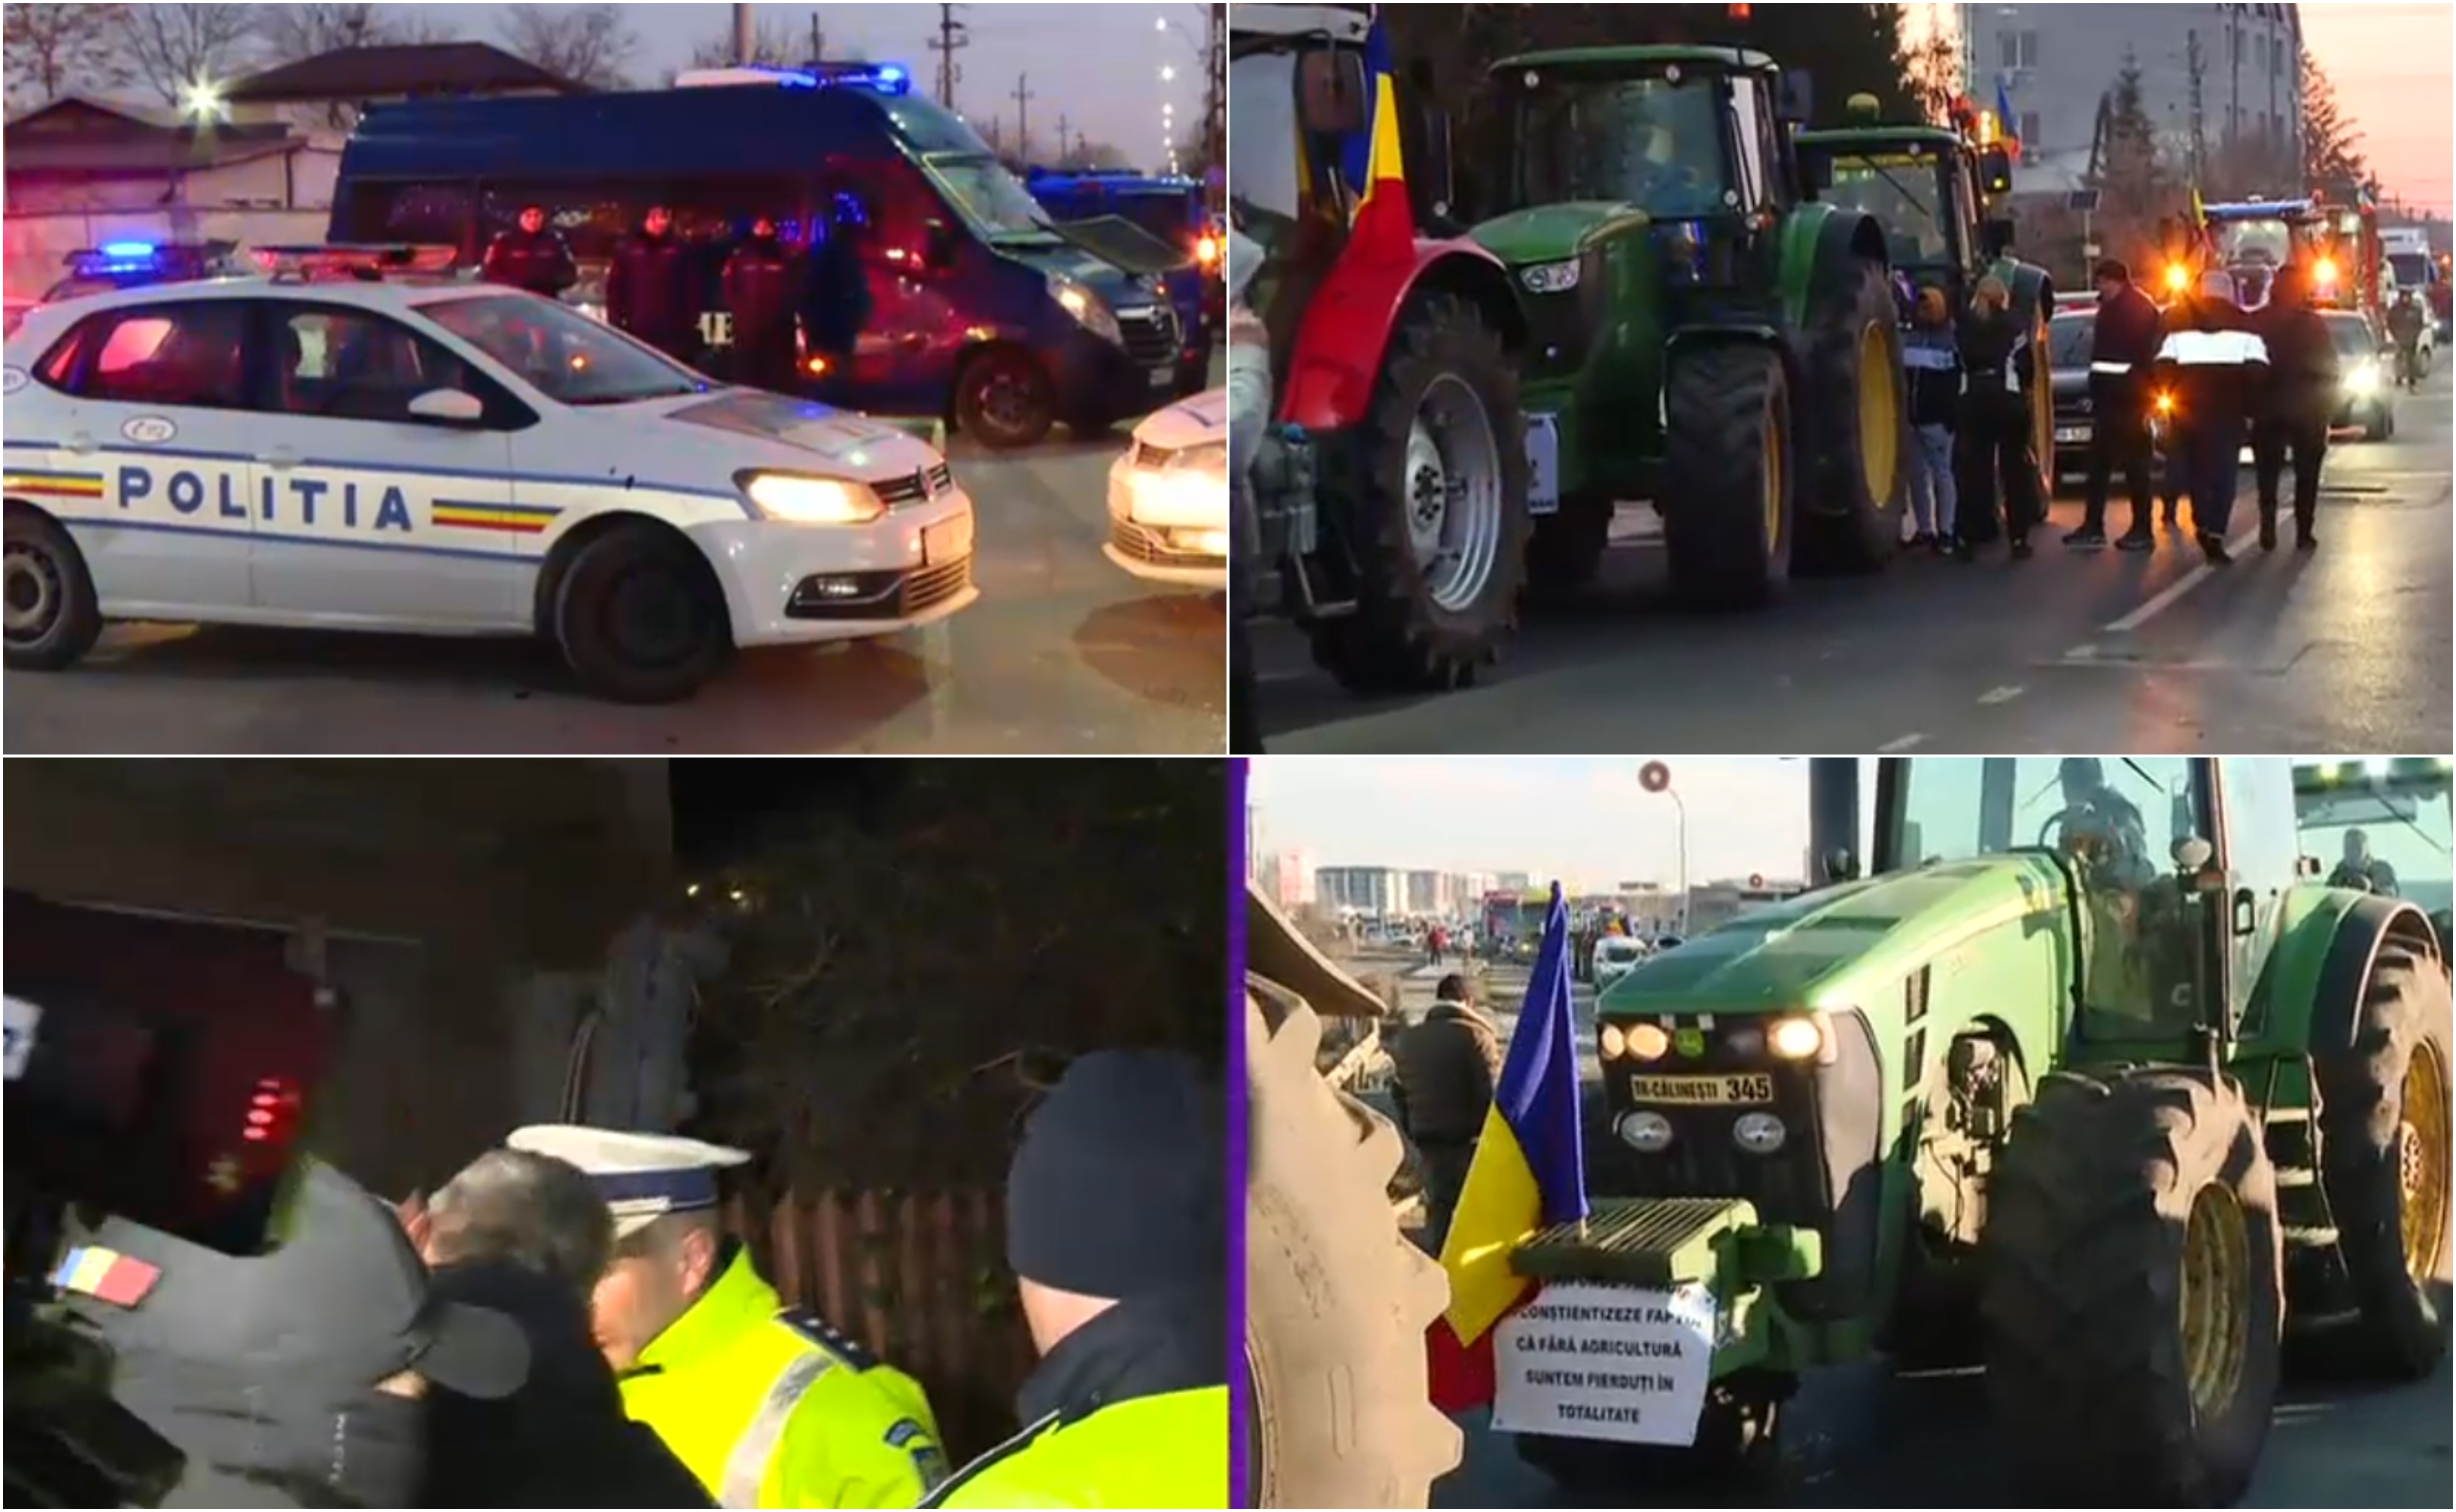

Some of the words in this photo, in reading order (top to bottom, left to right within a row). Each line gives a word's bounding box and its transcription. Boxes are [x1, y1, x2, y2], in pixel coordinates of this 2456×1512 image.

[119, 466, 412, 532] POLITIA
[1726, 1076, 1771, 1101] 345
[1538, 1336, 1577, 1354] FĂRĂ
[1579, 1339, 1683, 1359] AGRICULTURĂ
[1525, 1368, 1584, 1387] SUNTEM
[1557, 1404, 1641, 1424] TOTALITATE
